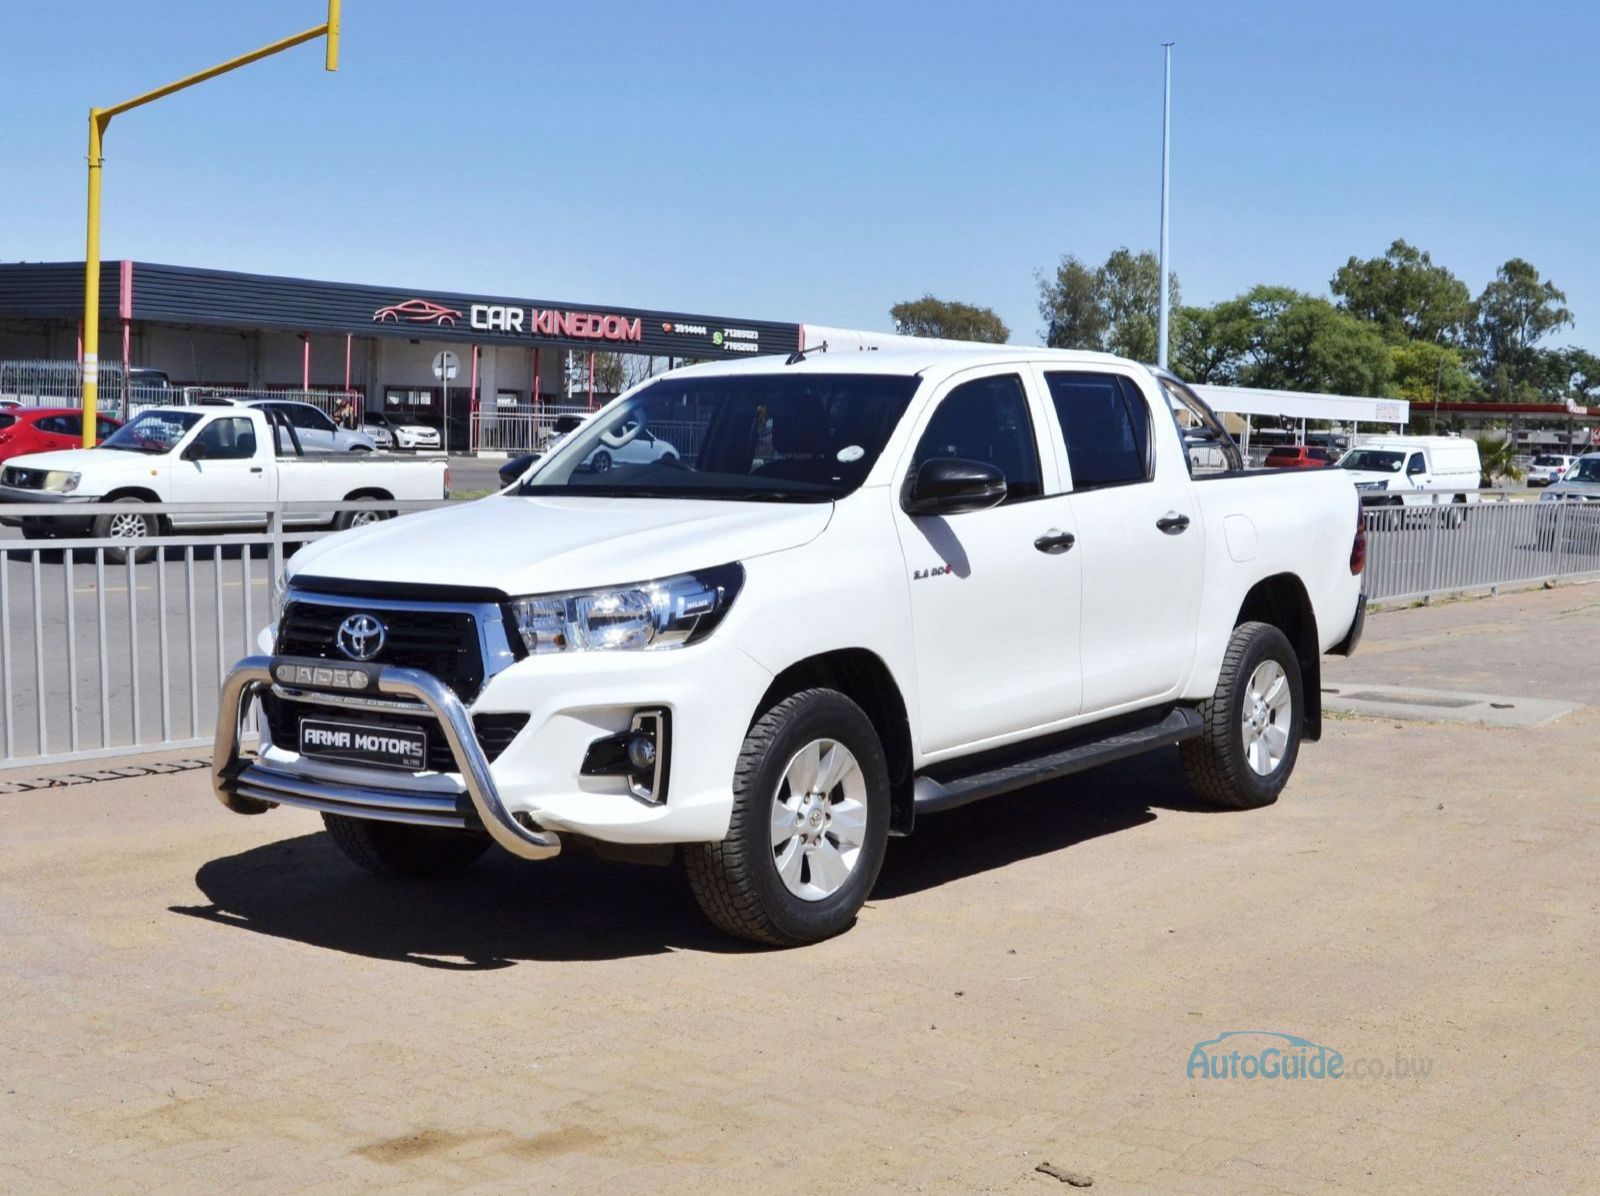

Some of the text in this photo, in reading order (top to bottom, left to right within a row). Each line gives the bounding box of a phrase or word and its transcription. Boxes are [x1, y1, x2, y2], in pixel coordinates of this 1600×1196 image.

[470, 304, 642, 341] CAR KINGDOM
[304, 728, 423, 757] ARMA MOTORS
